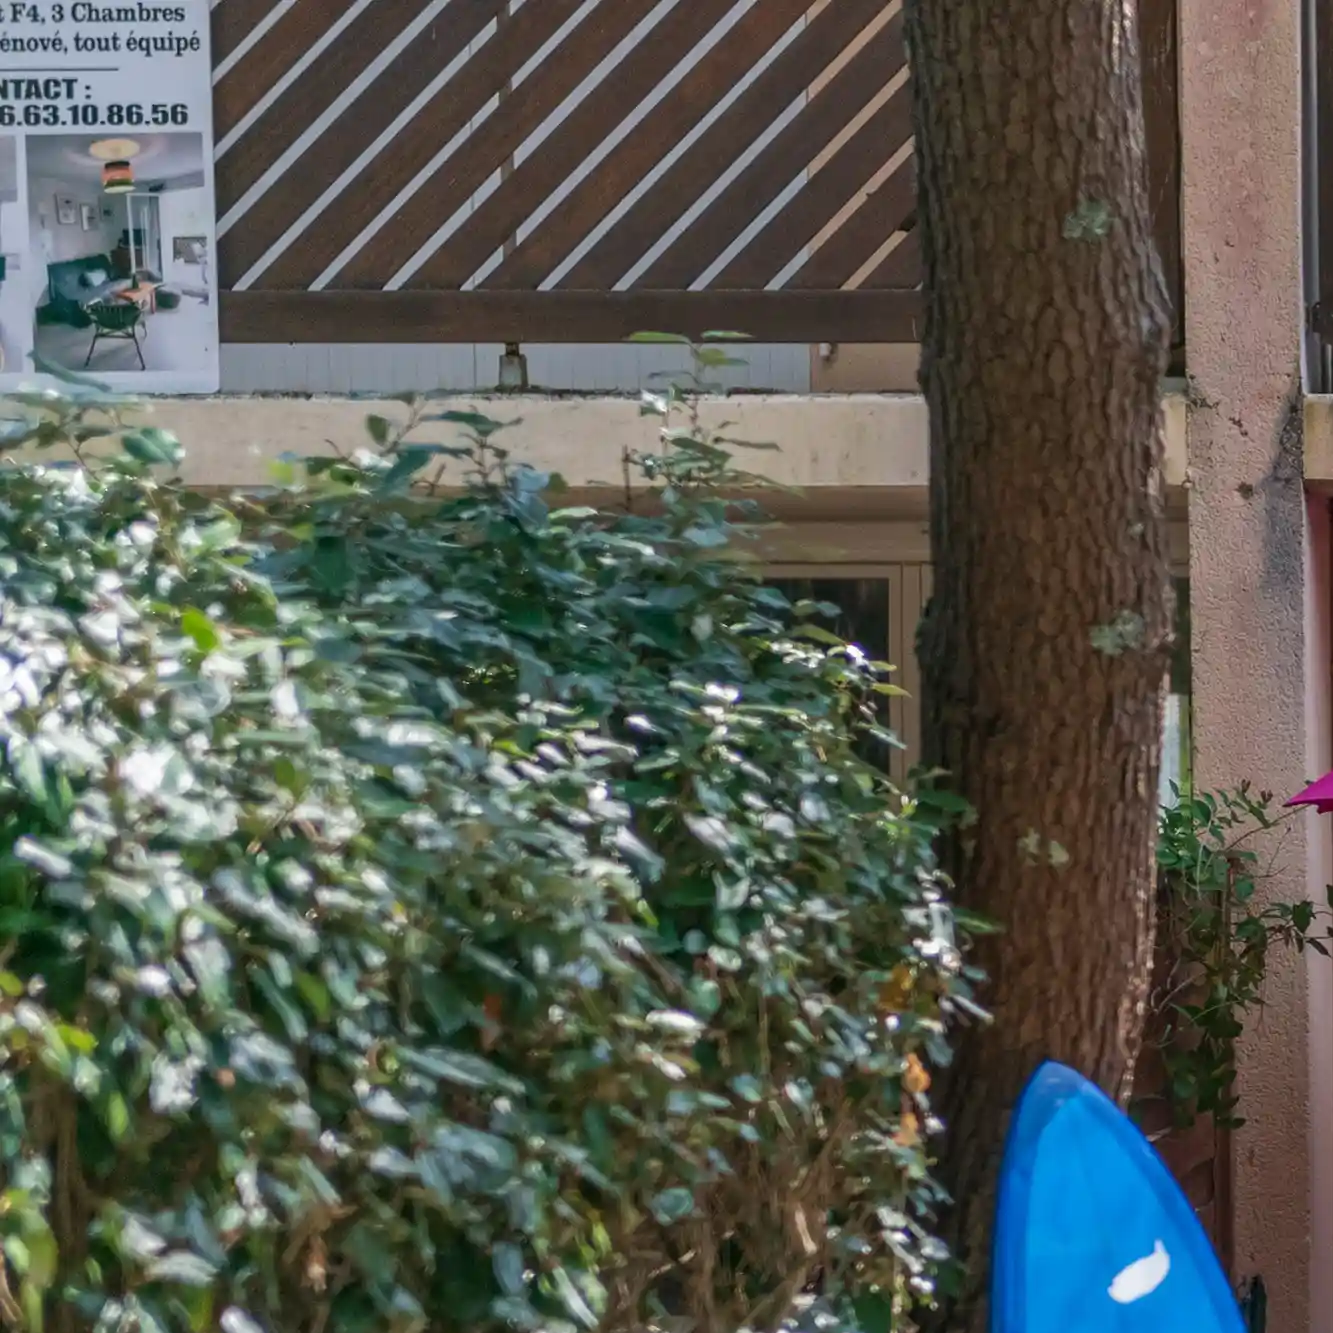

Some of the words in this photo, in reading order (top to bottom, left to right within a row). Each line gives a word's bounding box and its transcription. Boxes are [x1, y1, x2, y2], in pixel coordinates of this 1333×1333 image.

[10, 2, 46, 25] F4,
[51, 3, 64, 22] 3
[71, 2, 186, 22] Chambres
[73, 32, 121, 51] tout
[126, 31, 201, 57] équipé
